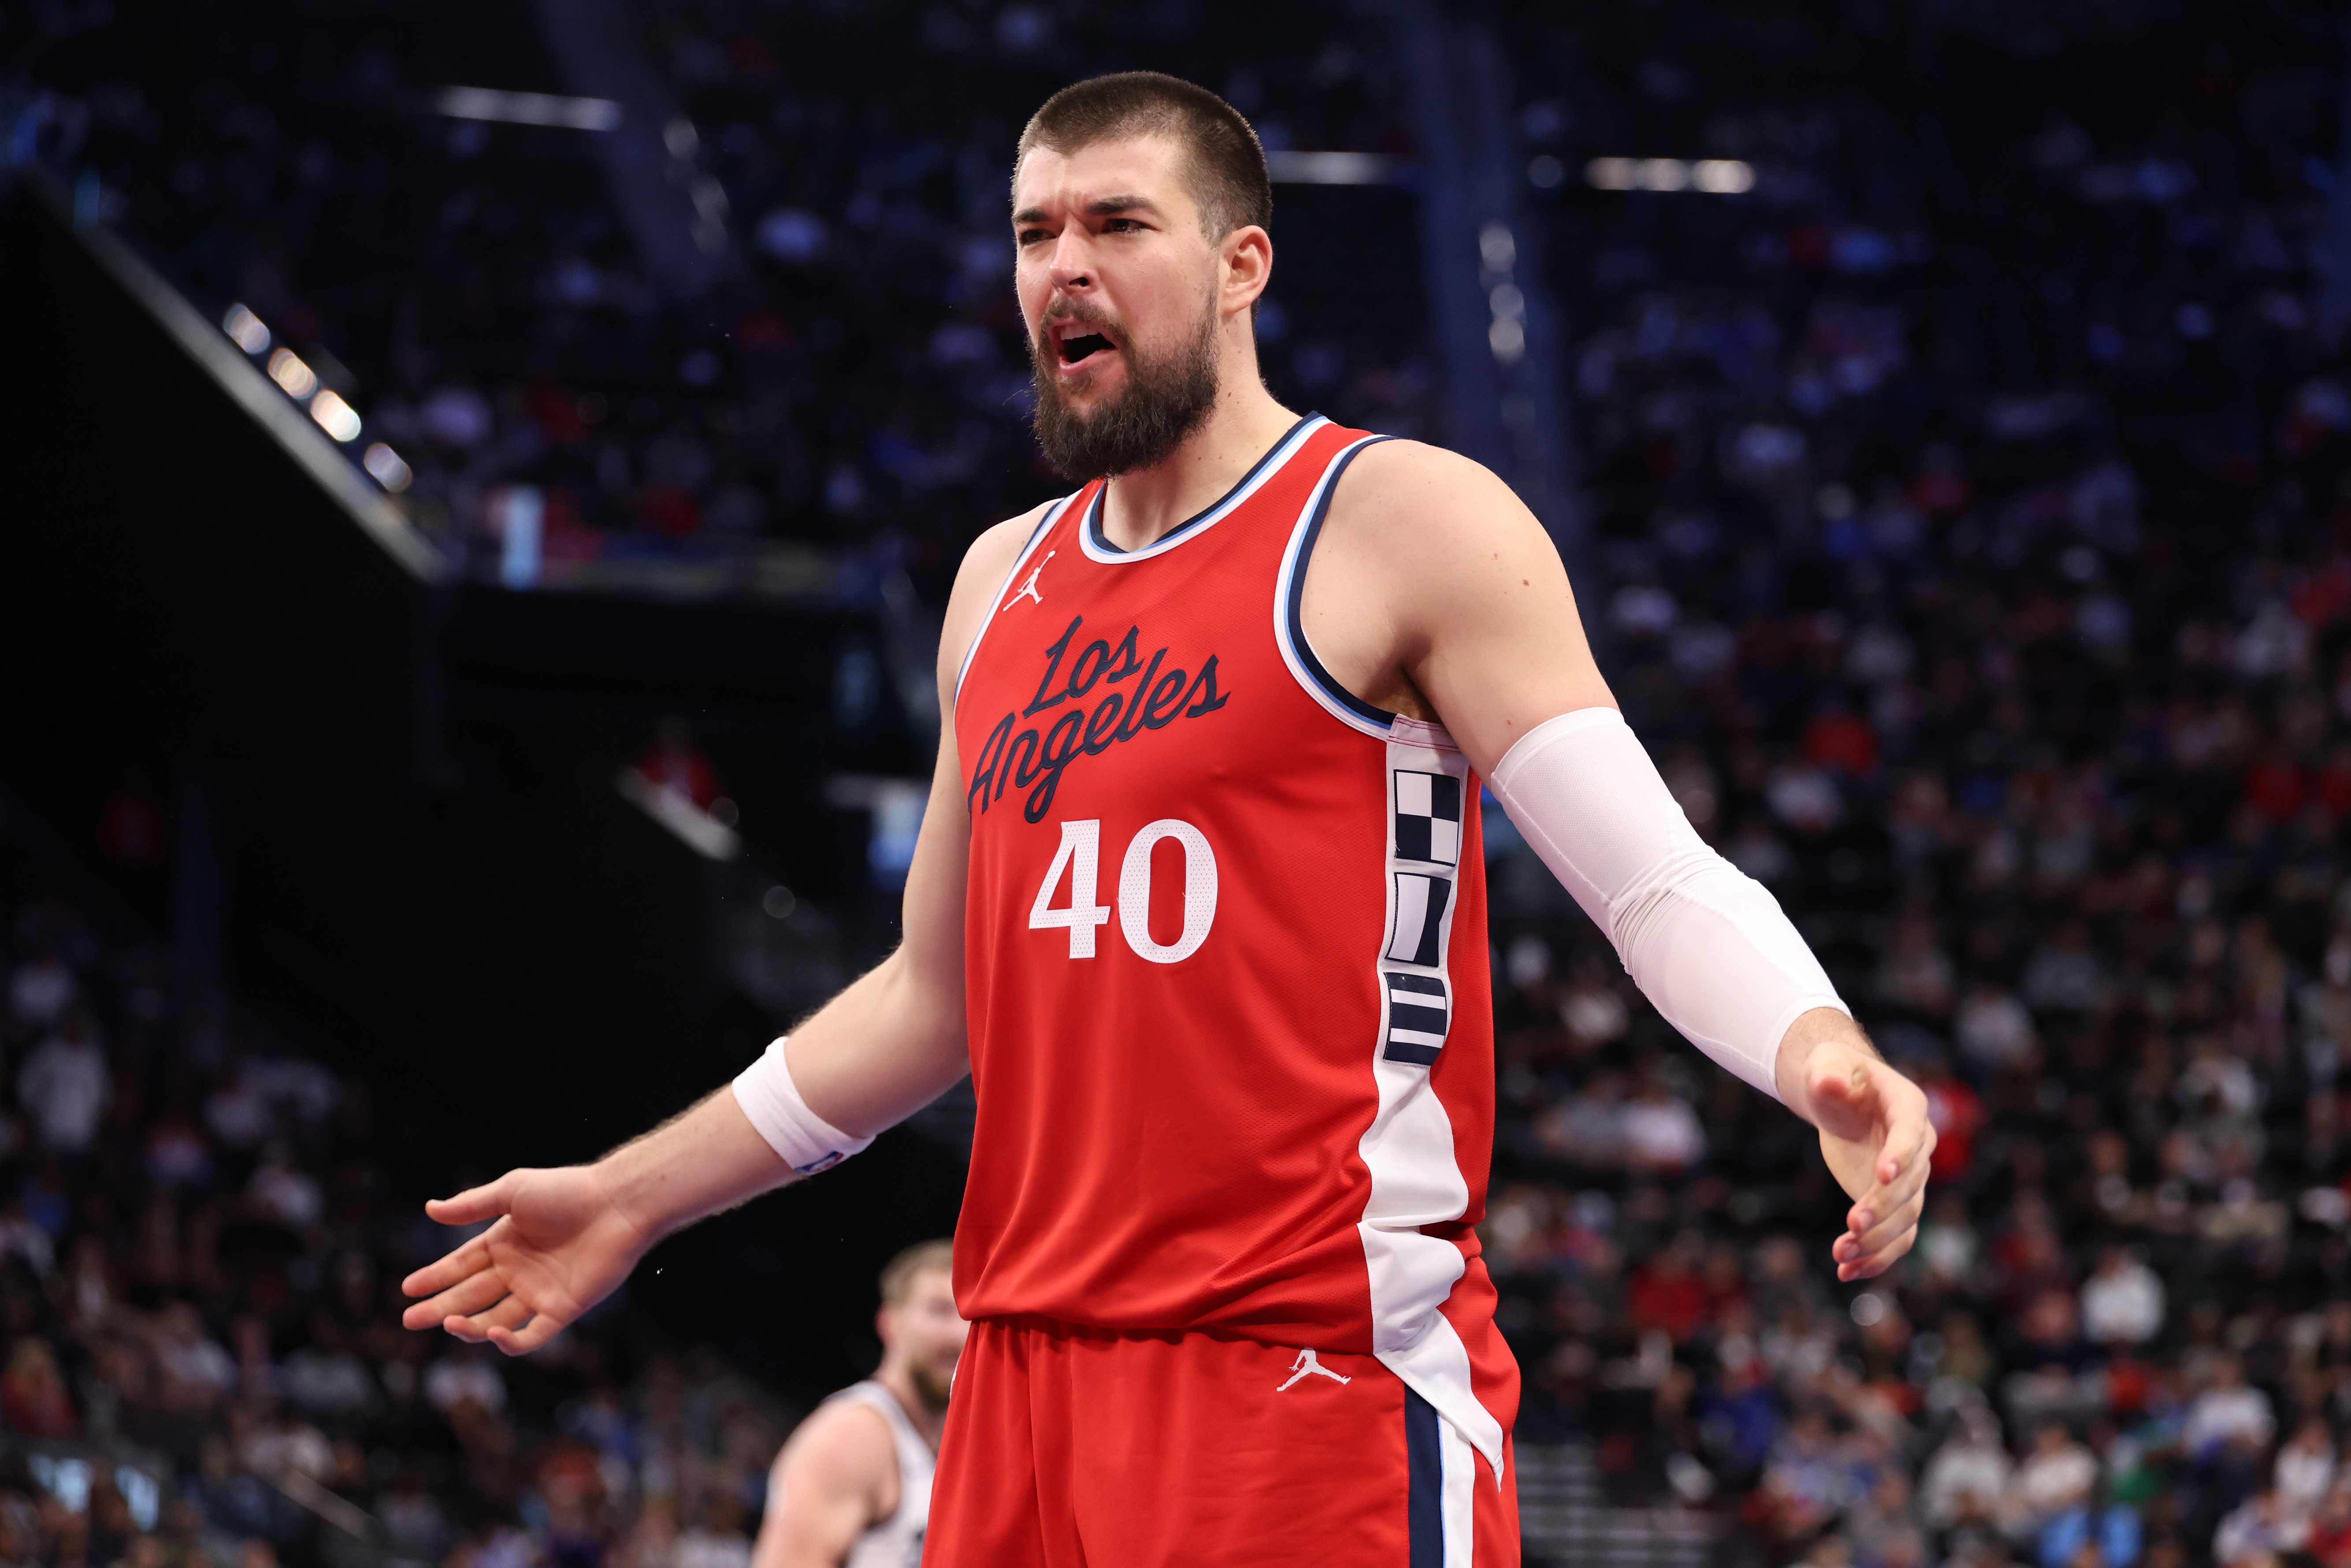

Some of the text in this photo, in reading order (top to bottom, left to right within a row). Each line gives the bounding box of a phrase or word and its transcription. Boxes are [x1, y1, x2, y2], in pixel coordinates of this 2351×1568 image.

[968, 647, 1231, 824] Angeles
[1023, 615, 1144, 719] Los
[1029, 819, 1218, 963] 40
